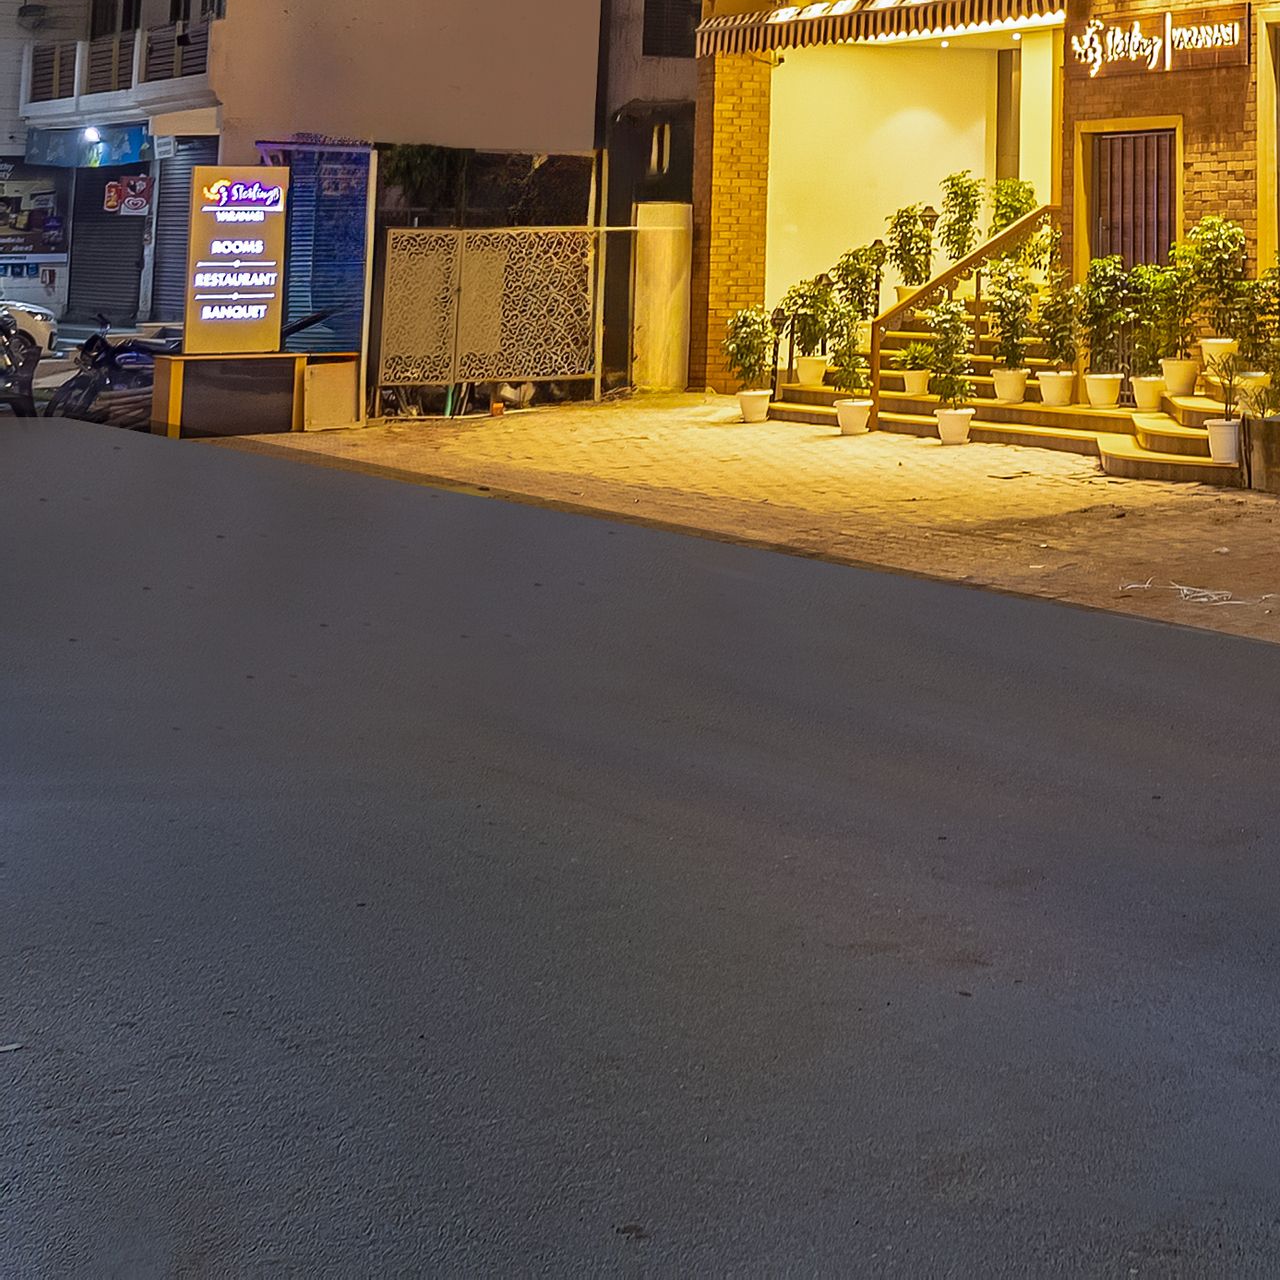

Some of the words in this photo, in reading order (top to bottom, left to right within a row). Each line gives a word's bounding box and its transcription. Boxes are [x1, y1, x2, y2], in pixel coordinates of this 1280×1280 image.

[1172, 21, 1239, 49] VARANASI
[211, 240, 264, 254] ROOMS
[195, 273, 278, 287] RESTAURANT
[202, 305, 267, 319] BANQUET
